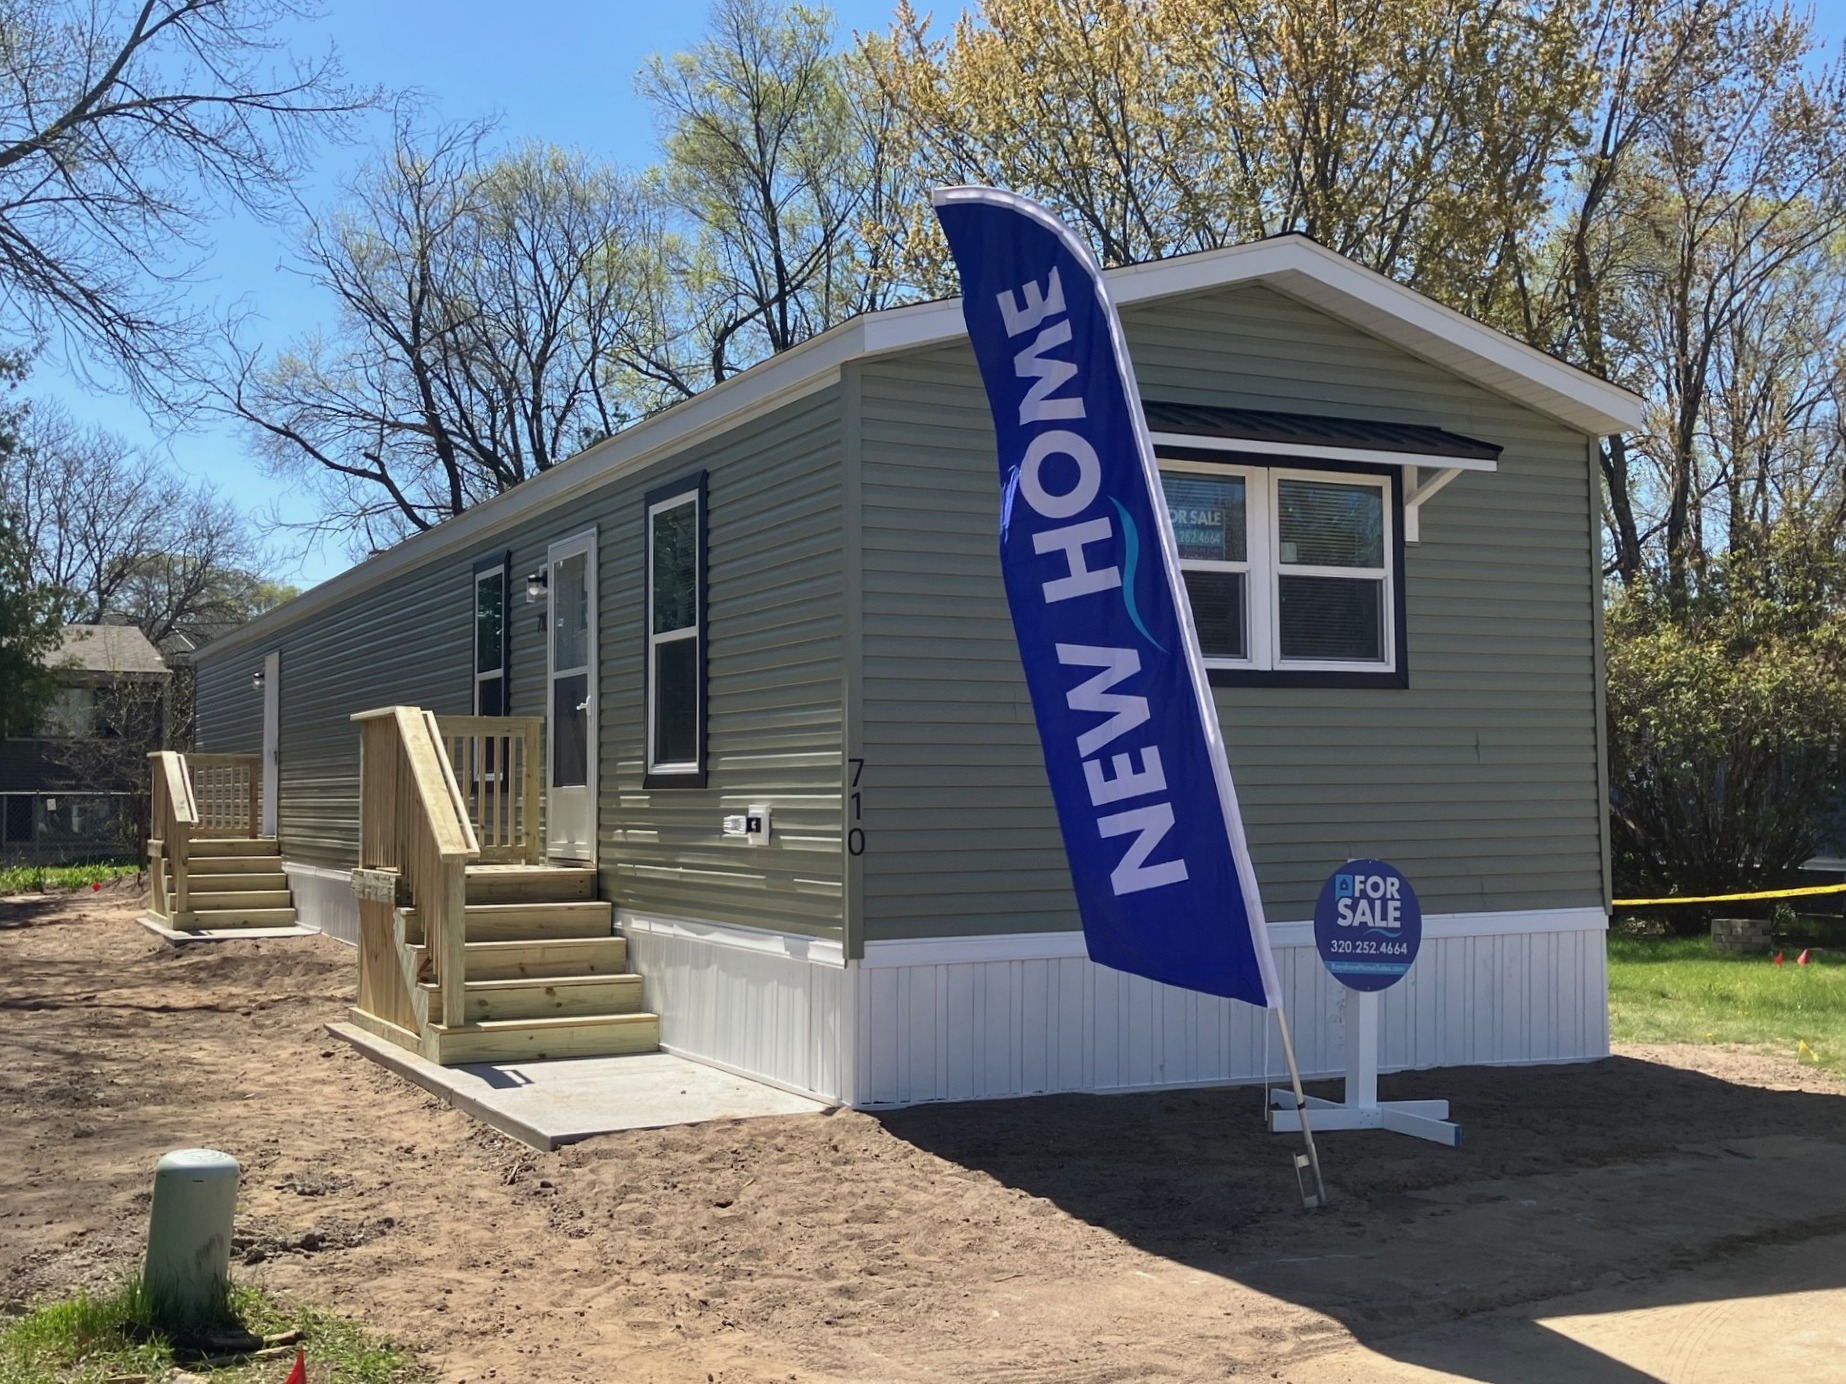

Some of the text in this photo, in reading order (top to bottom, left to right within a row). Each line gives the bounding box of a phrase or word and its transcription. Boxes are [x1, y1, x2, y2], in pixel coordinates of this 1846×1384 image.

[1169, 508, 1221, 525] OR SALE
[997, 265, 1189, 896] NEW HOME
[848, 758, 866, 856] 710
[1354, 875, 1400, 898] FOR
[1337, 897, 1402, 928] SALE
[1330, 940, 1408, 955] 320.252.4664
